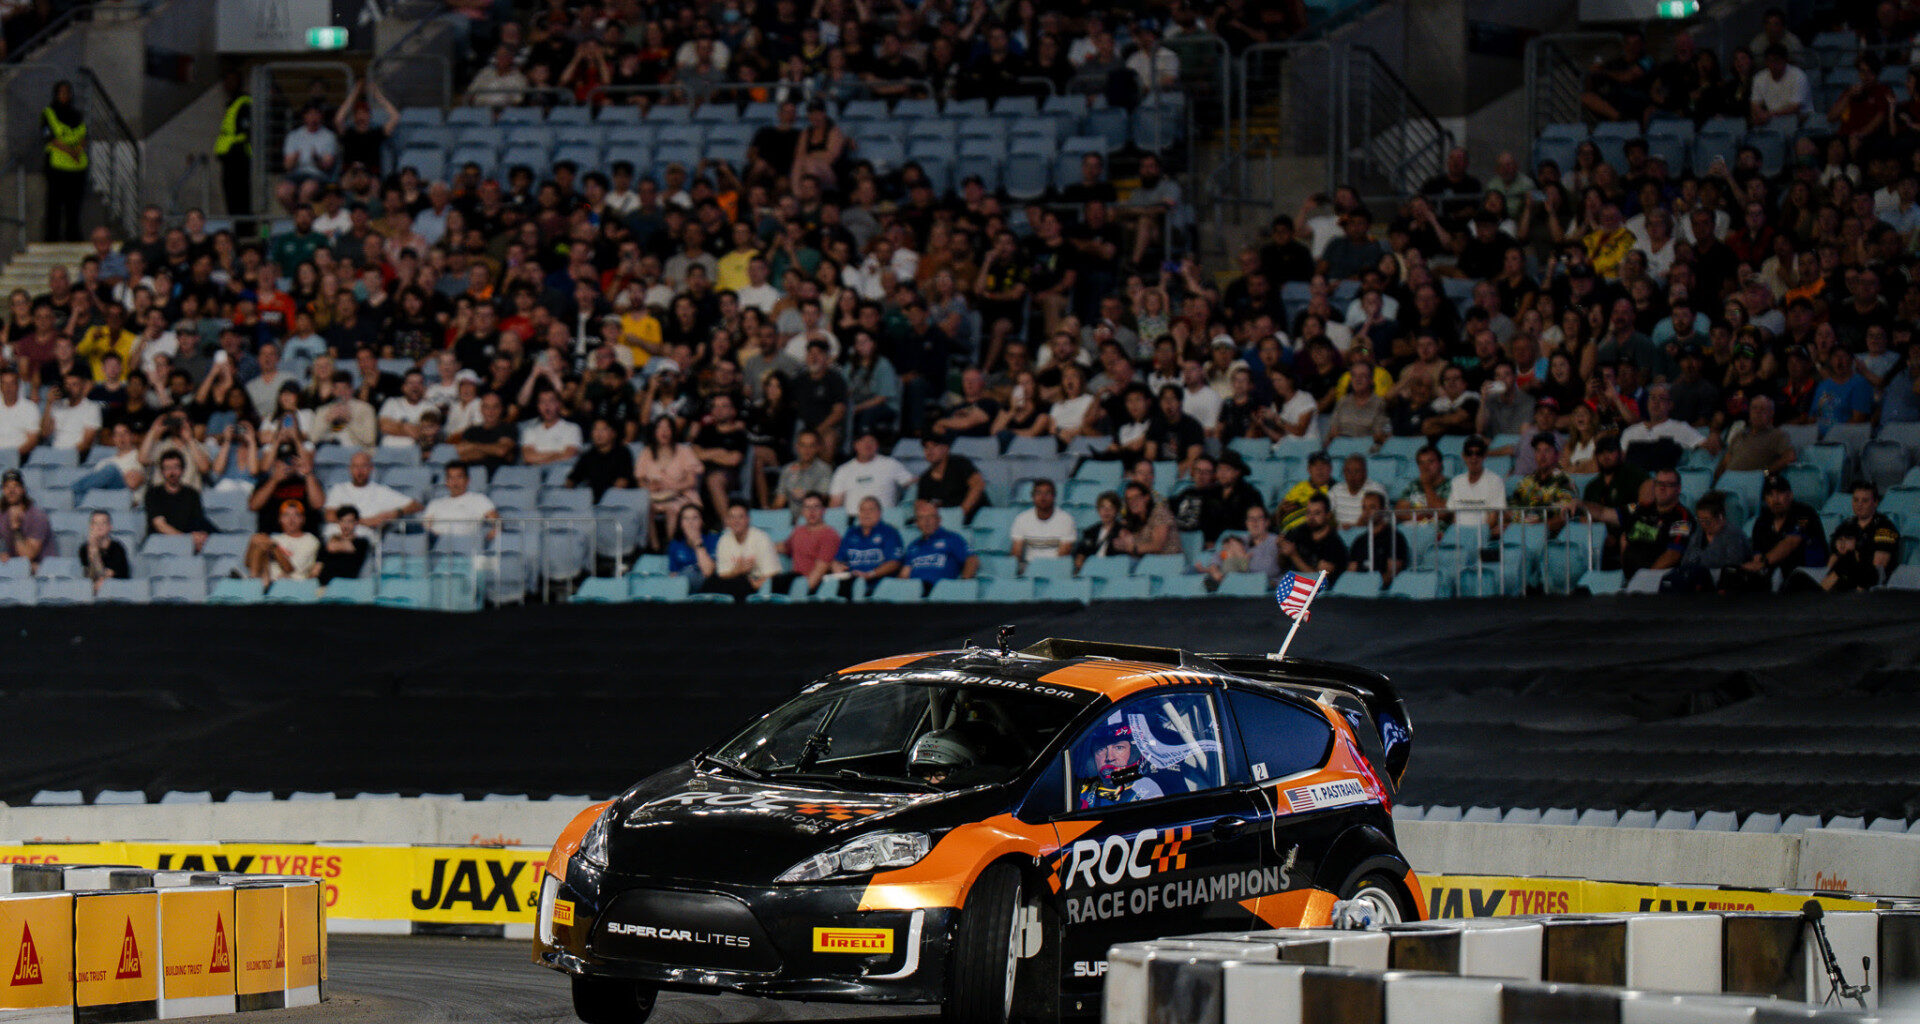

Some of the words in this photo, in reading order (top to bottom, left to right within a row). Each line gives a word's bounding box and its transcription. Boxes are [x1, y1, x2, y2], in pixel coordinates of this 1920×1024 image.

[1256, 765, 1265, 780] 2
[1311, 788, 1322, 801] T.
[1323, 781, 1364, 800] PASTRANA
[259, 855, 342, 878] TYRES
[1066, 828, 1158, 891] ROC
[411, 858, 528, 912] JAX
[1066, 890, 1125, 925] RACE
[1130, 885, 1159, 915] OF
[1162, 865, 1291, 909] CHAMPIONS
[1508, 889, 1569, 915] TYRES
[695, 933, 750, 948] LITES
[821, 932, 886, 948] PIRELLI
[16, 941, 39, 980] Sika
[120, 936, 139, 974] Sika
[90, 970, 107, 981] TRUST
[166, 965, 187, 977] BUILDING
[187, 964, 202, 975] TRUST
[1074, 961, 1109, 977] SUP
